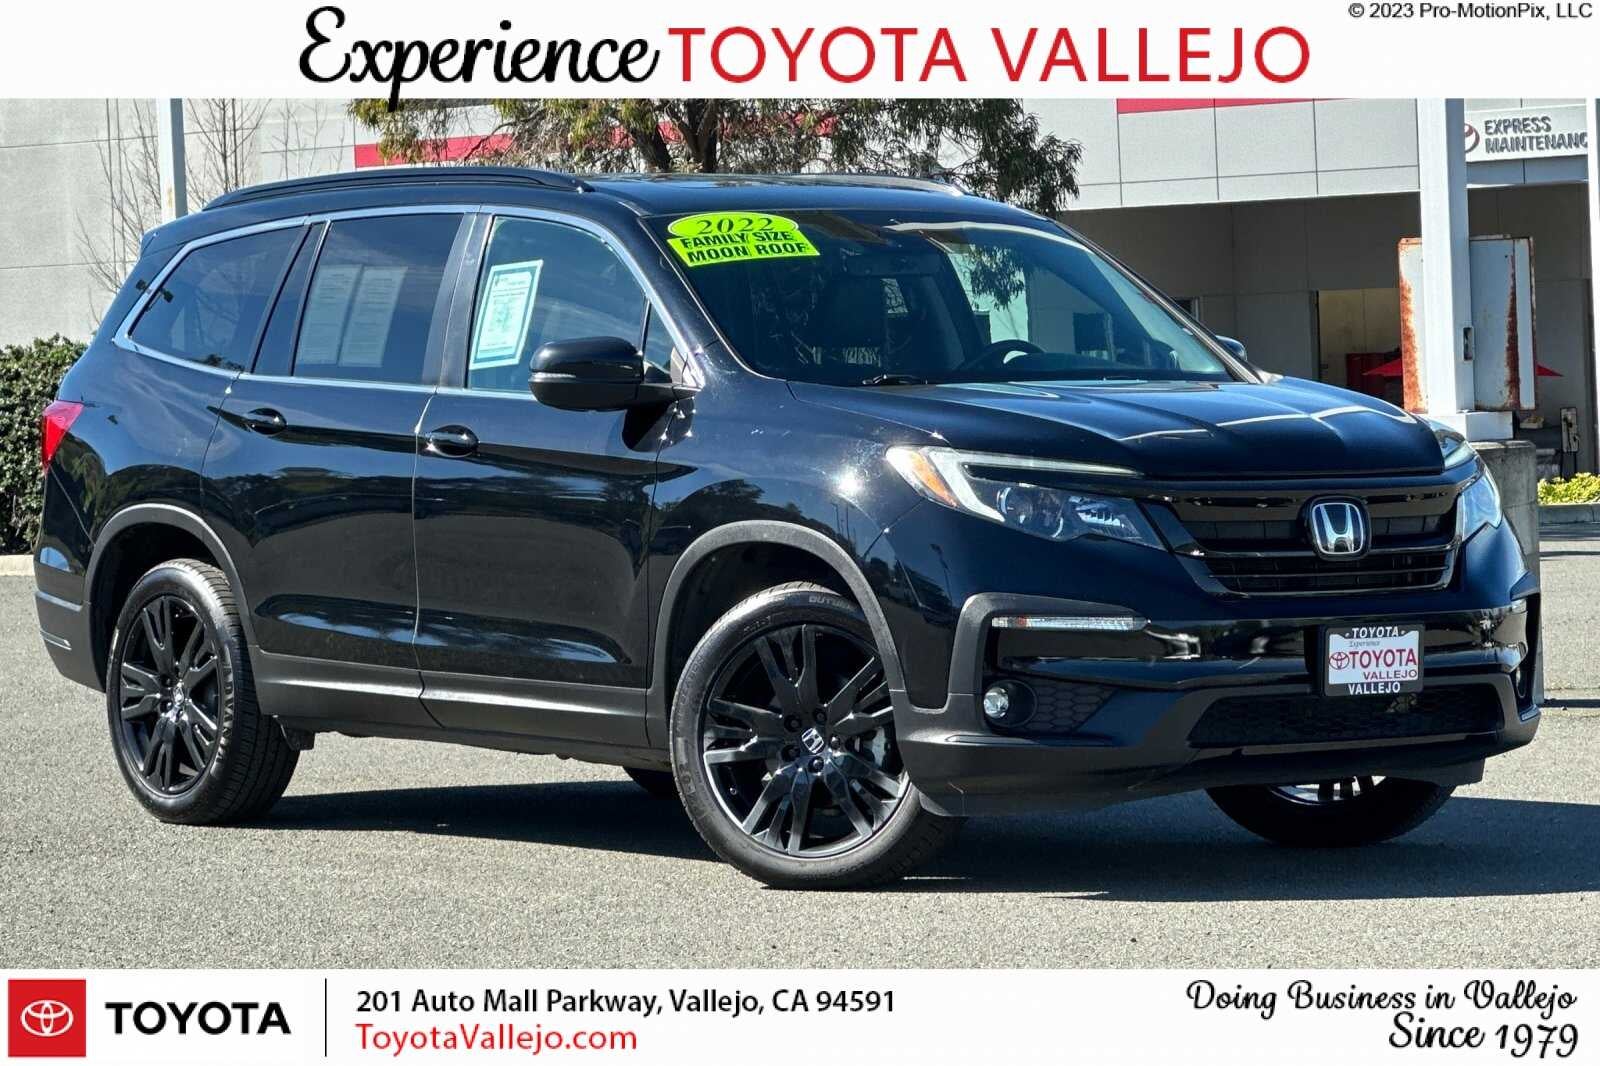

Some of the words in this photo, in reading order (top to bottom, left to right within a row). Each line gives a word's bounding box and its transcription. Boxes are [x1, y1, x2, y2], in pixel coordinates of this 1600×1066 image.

[1484, 116, 1552, 136] EXPRESS
[696, 217, 774, 235] 2022
[680, 231, 748, 249] FAMILY
[752, 231, 793, 242] SIZE
[687, 245, 748, 263] MOON
[754, 242, 807, 256] ROOF
[1351, 626, 1399, 639] TOYOTA
[1348, 648, 1417, 669] TOYOTA
[1363, 669, 1418, 681] VALLEJO
[1348, 682, 1401, 696] VALLEJO
